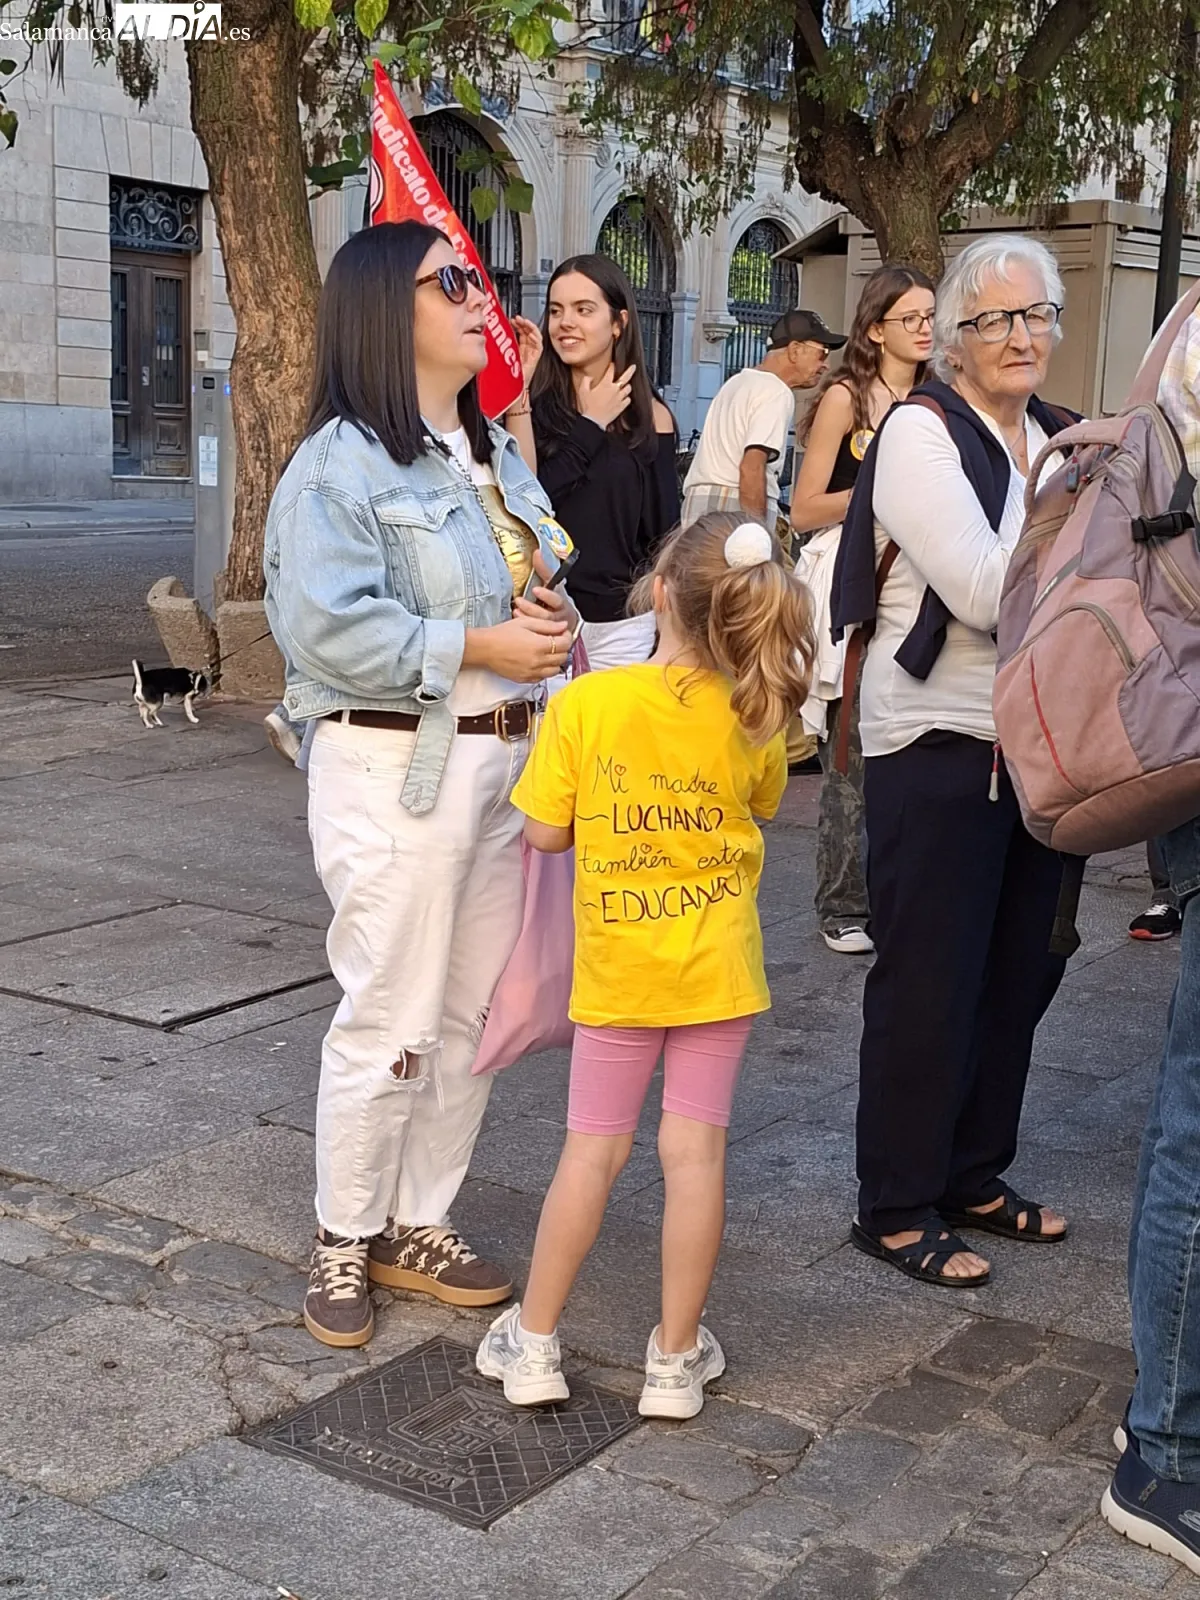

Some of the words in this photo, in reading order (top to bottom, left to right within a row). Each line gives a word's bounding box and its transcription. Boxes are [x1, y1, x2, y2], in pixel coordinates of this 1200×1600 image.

[370, 82, 431, 206] indicato
[592, 754, 630, 795] Mi
[649, 766, 720, 795] madre
[578, 842, 679, 875] también
